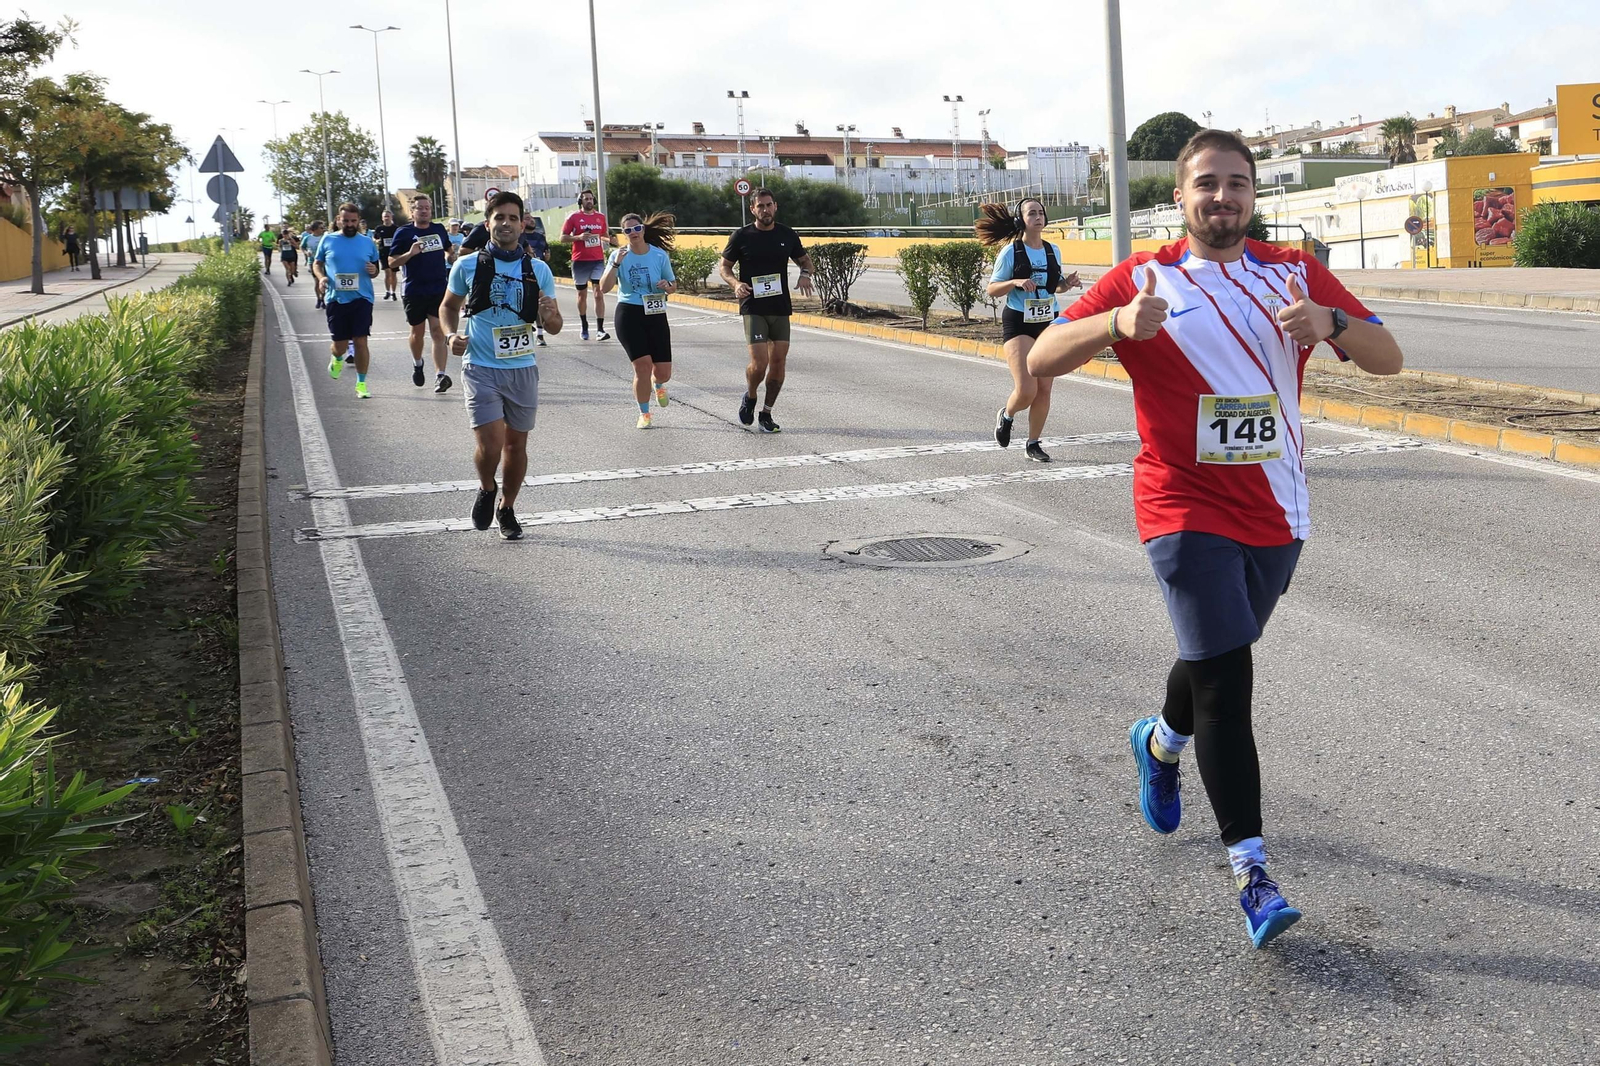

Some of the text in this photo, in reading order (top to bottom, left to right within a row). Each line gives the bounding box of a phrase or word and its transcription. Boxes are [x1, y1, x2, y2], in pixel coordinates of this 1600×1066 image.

[764, 282, 771, 290] 5
[1029, 305, 1051, 316] 152
[499, 335, 530, 349] 373
[1214, 401, 1271, 411] CARRERA URBANA
[1247, 408, 1272, 417] ALGECIRAS
[1209, 416, 1276, 444] 148
